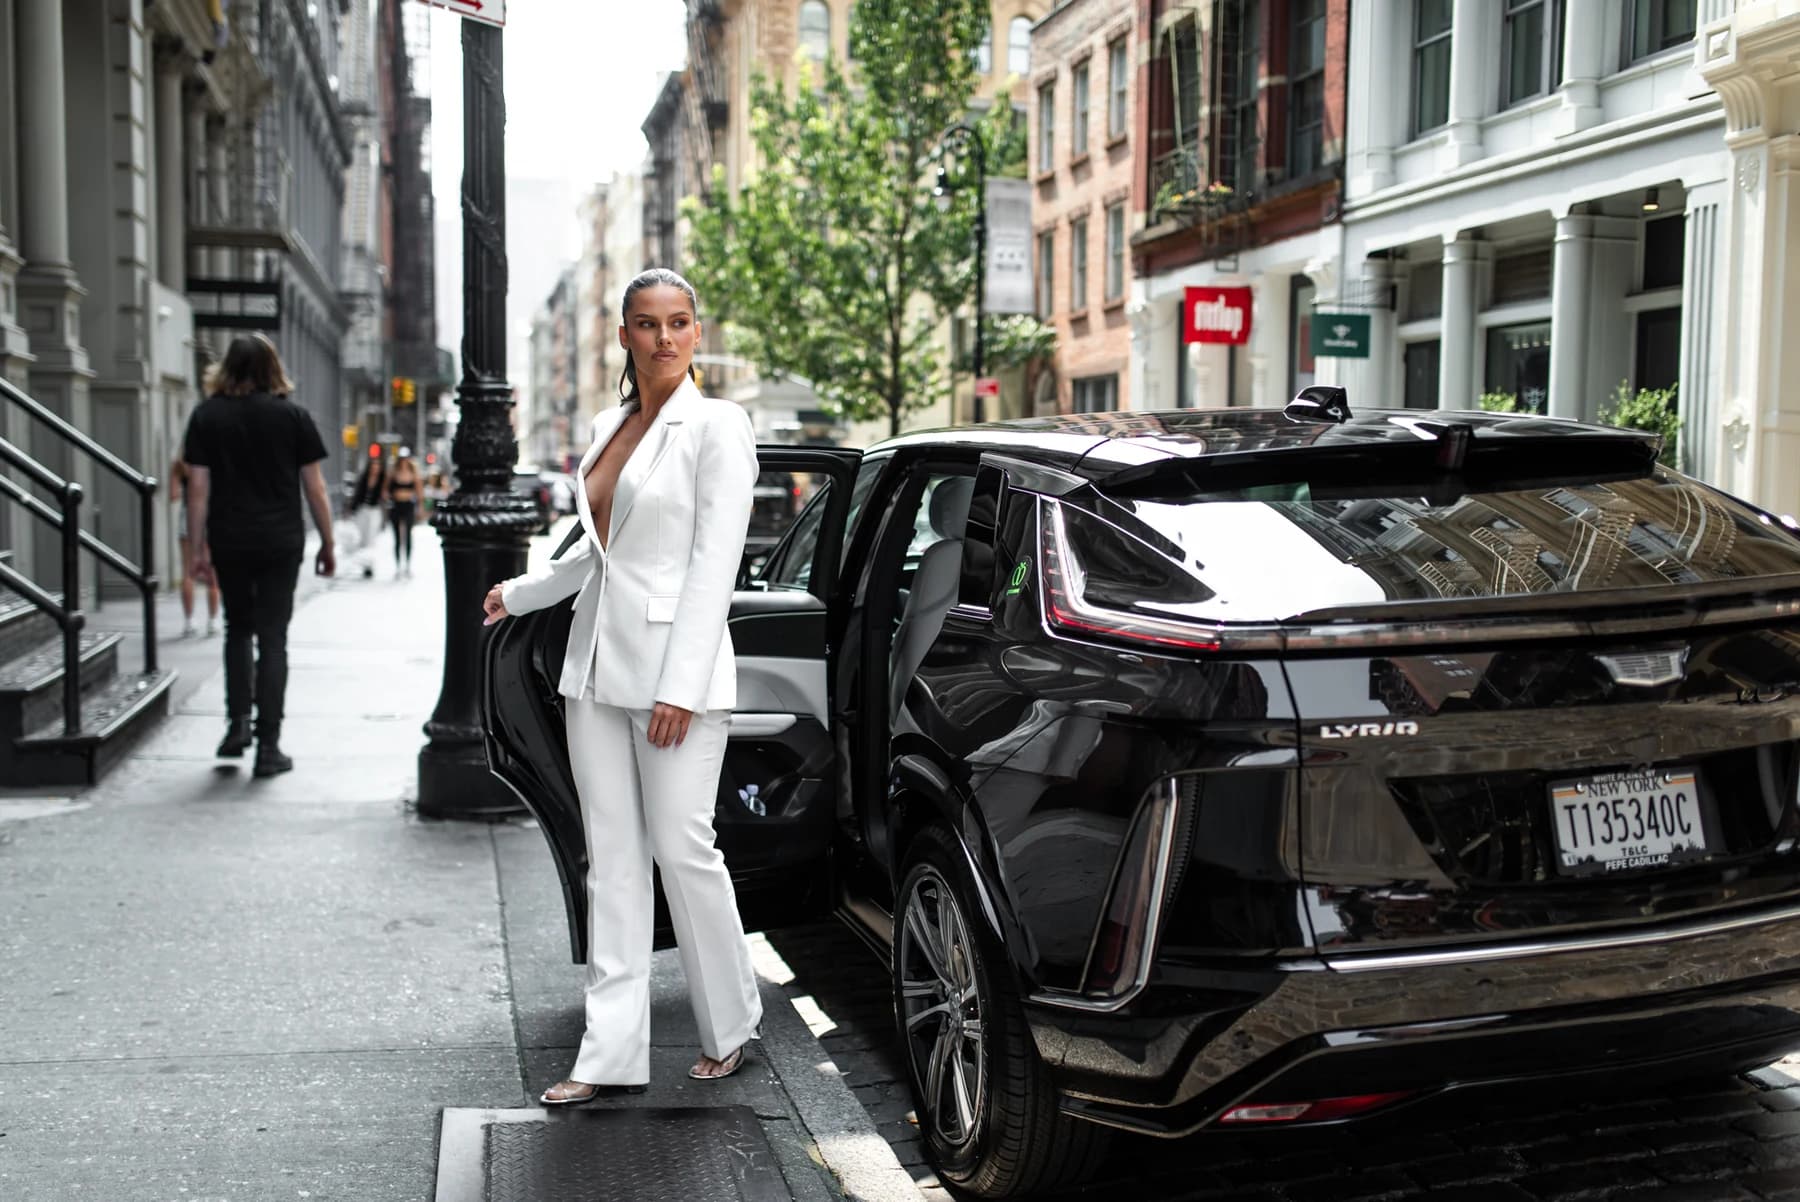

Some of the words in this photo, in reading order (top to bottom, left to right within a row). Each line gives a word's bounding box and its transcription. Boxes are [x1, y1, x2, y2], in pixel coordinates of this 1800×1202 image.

[1588, 781, 1620, 798] NEW
[1624, 777, 1662, 794] YORK
[1563, 792, 1691, 849] T135340C
[1621, 844, 1648, 857] T&LC
[1605, 859, 1627, 871] PEPE
[1628, 854, 1669, 867] CADILLAC
